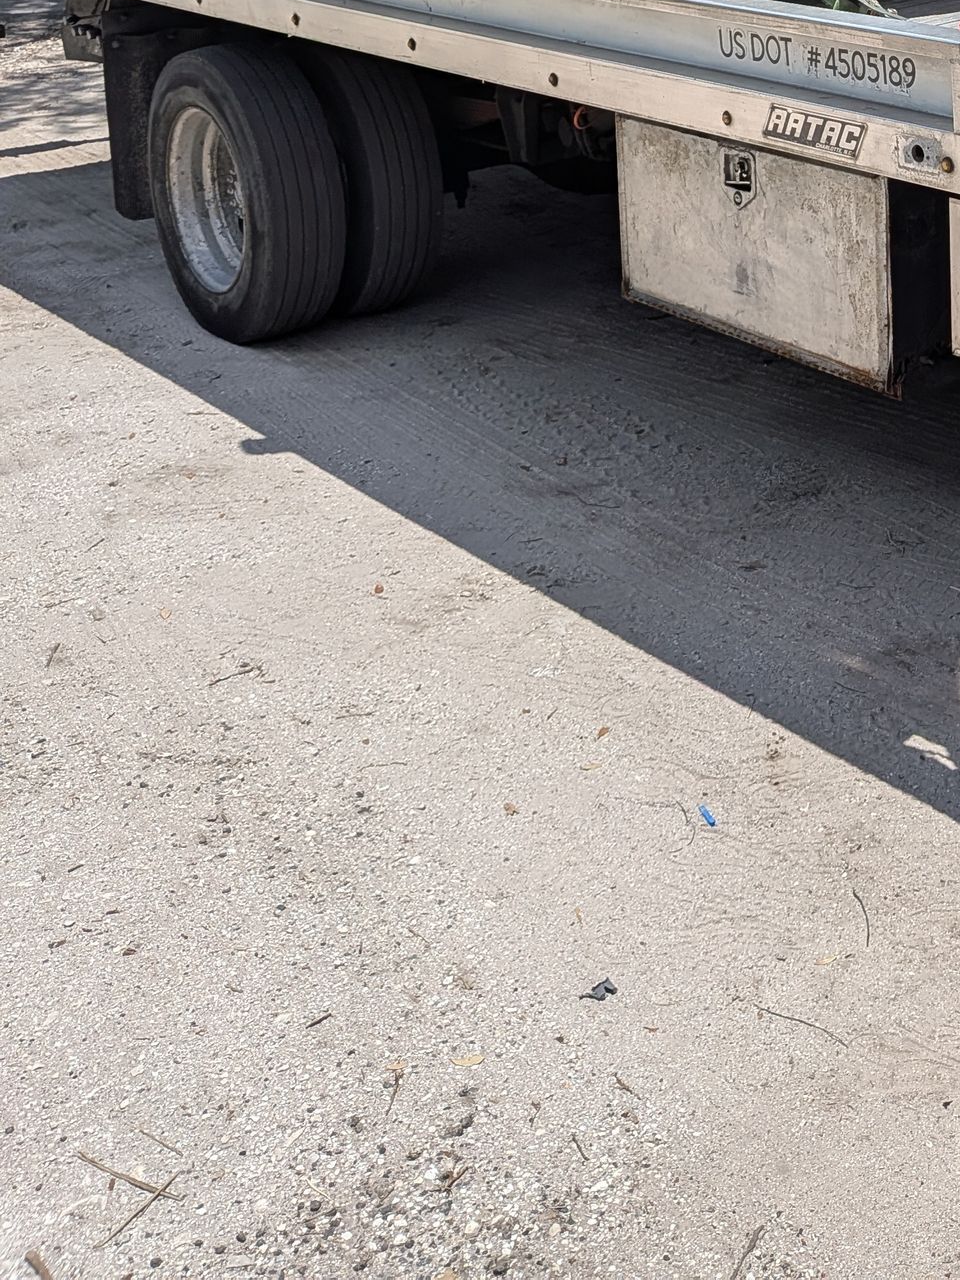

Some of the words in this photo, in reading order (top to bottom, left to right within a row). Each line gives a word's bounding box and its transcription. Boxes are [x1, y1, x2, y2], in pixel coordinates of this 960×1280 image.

[718, 27, 746, 60] US
[751, 33, 792, 66] DOT
[807, 46, 916, 90] #4505189
[767, 108, 861, 151] AATAC
